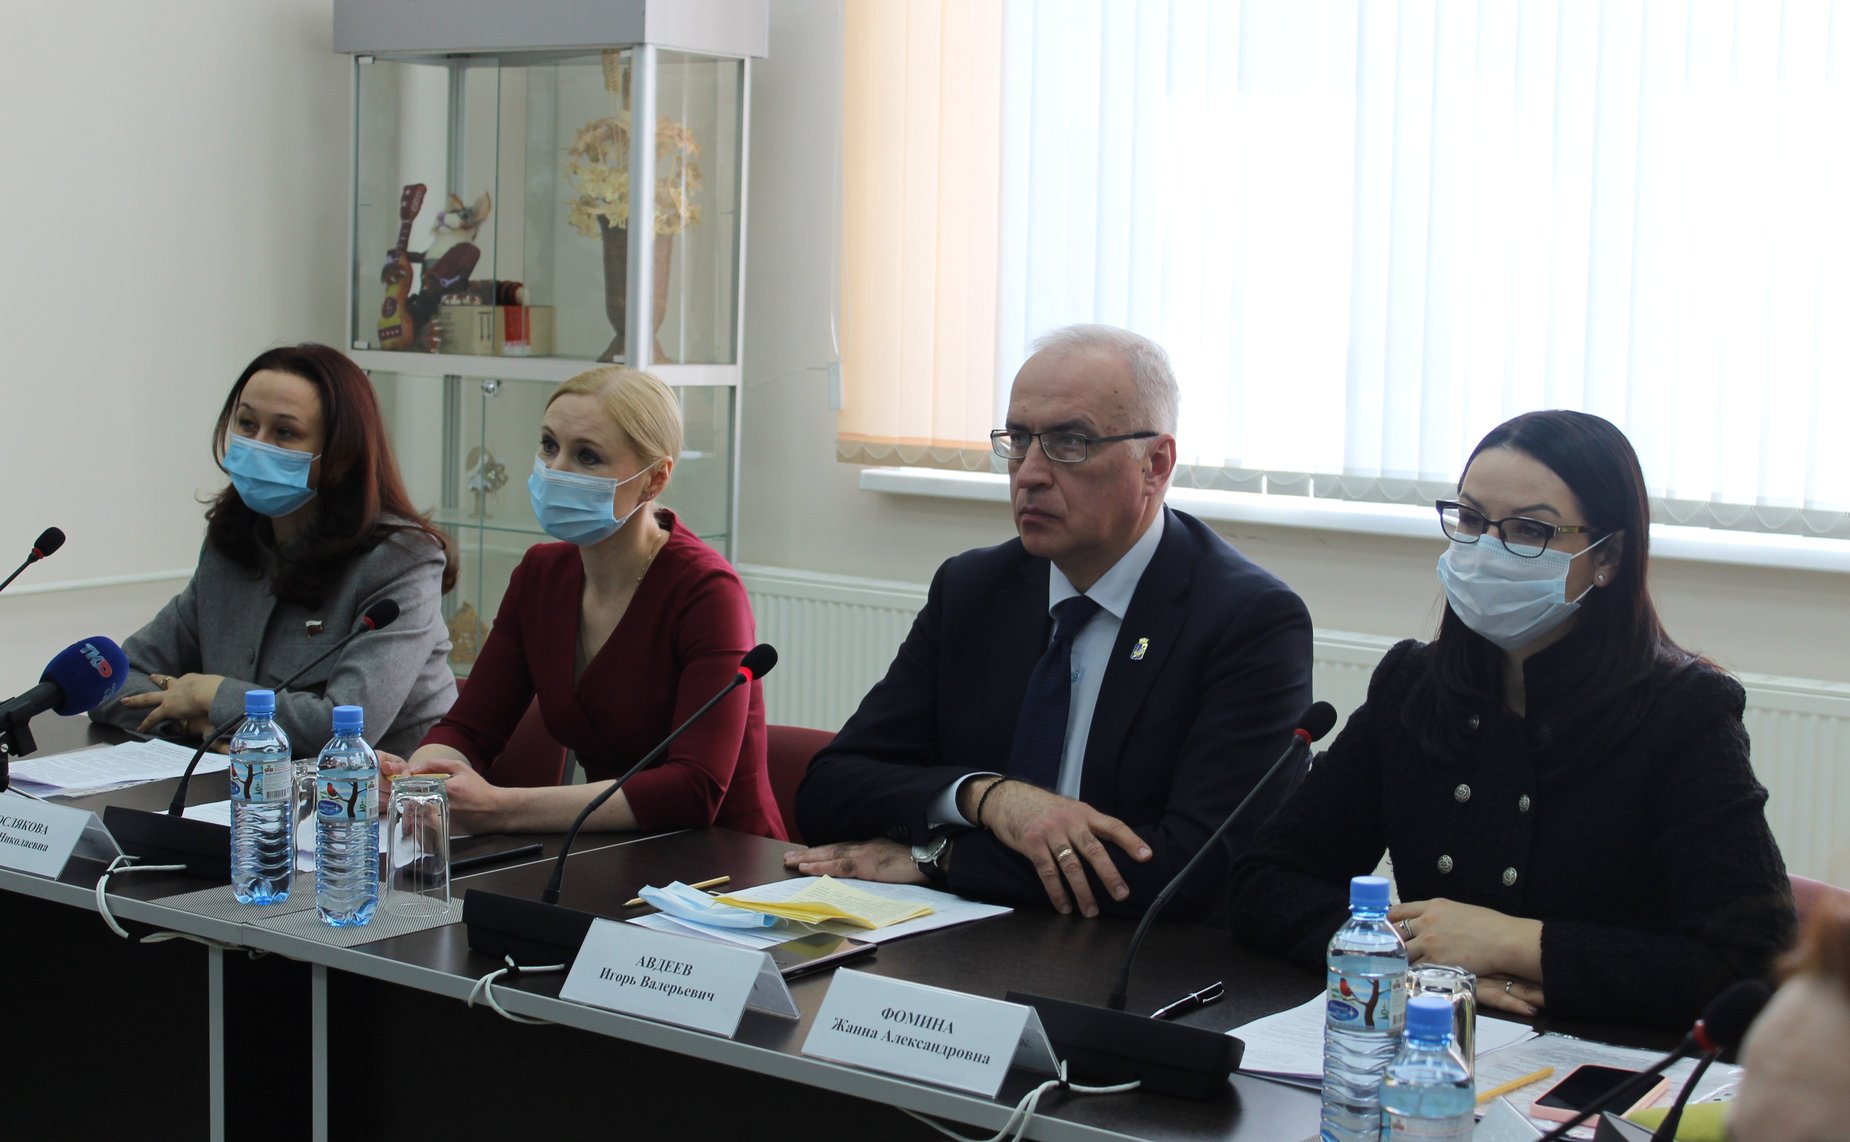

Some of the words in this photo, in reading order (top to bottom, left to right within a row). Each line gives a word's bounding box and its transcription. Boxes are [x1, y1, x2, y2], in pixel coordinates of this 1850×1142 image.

[635, 955, 693, 976] АВДЕЕВ
[599, 967, 636, 986] Игорь
[640, 975, 715, 1002] Валерьевич
[881, 1007, 954, 1034] ФОМИНА
[831, 1017, 878, 1039] Жанна
[880, 1029, 991, 1065] Александровна
